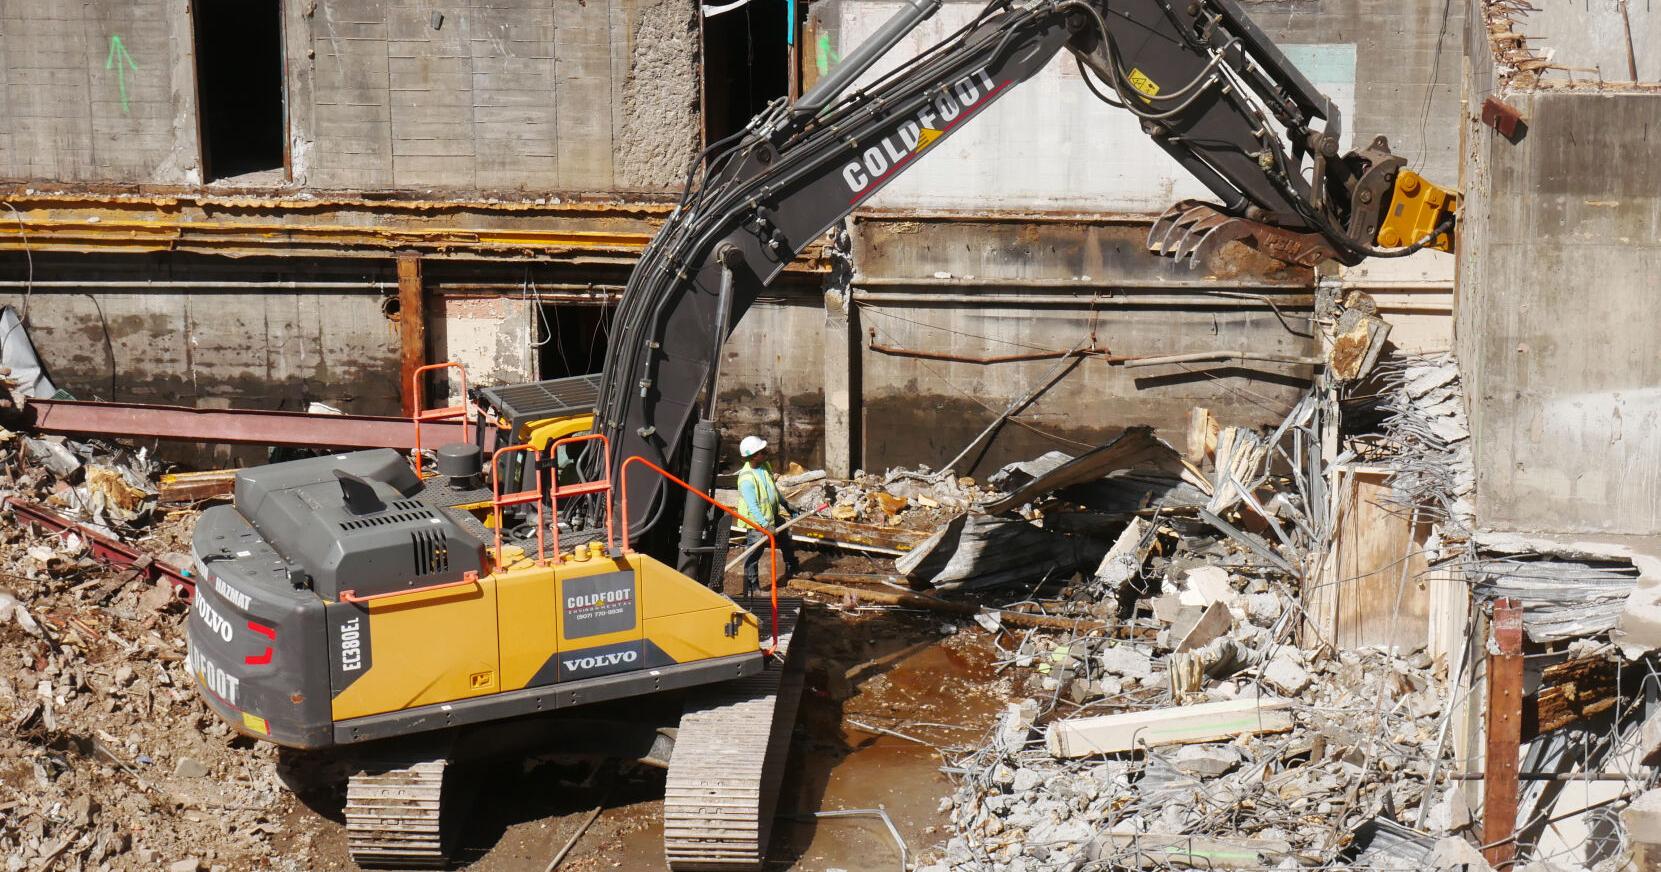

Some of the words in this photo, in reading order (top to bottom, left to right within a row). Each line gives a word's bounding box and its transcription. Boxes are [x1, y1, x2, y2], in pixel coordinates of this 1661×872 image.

[843, 67, 996, 193] COLDFOOT
[215, 576, 253, 611] HAZMAT
[567, 588, 631, 609] COLDFOOT
[195, 583, 233, 642] VOLVO
[563, 650, 638, 671] VOLVO
